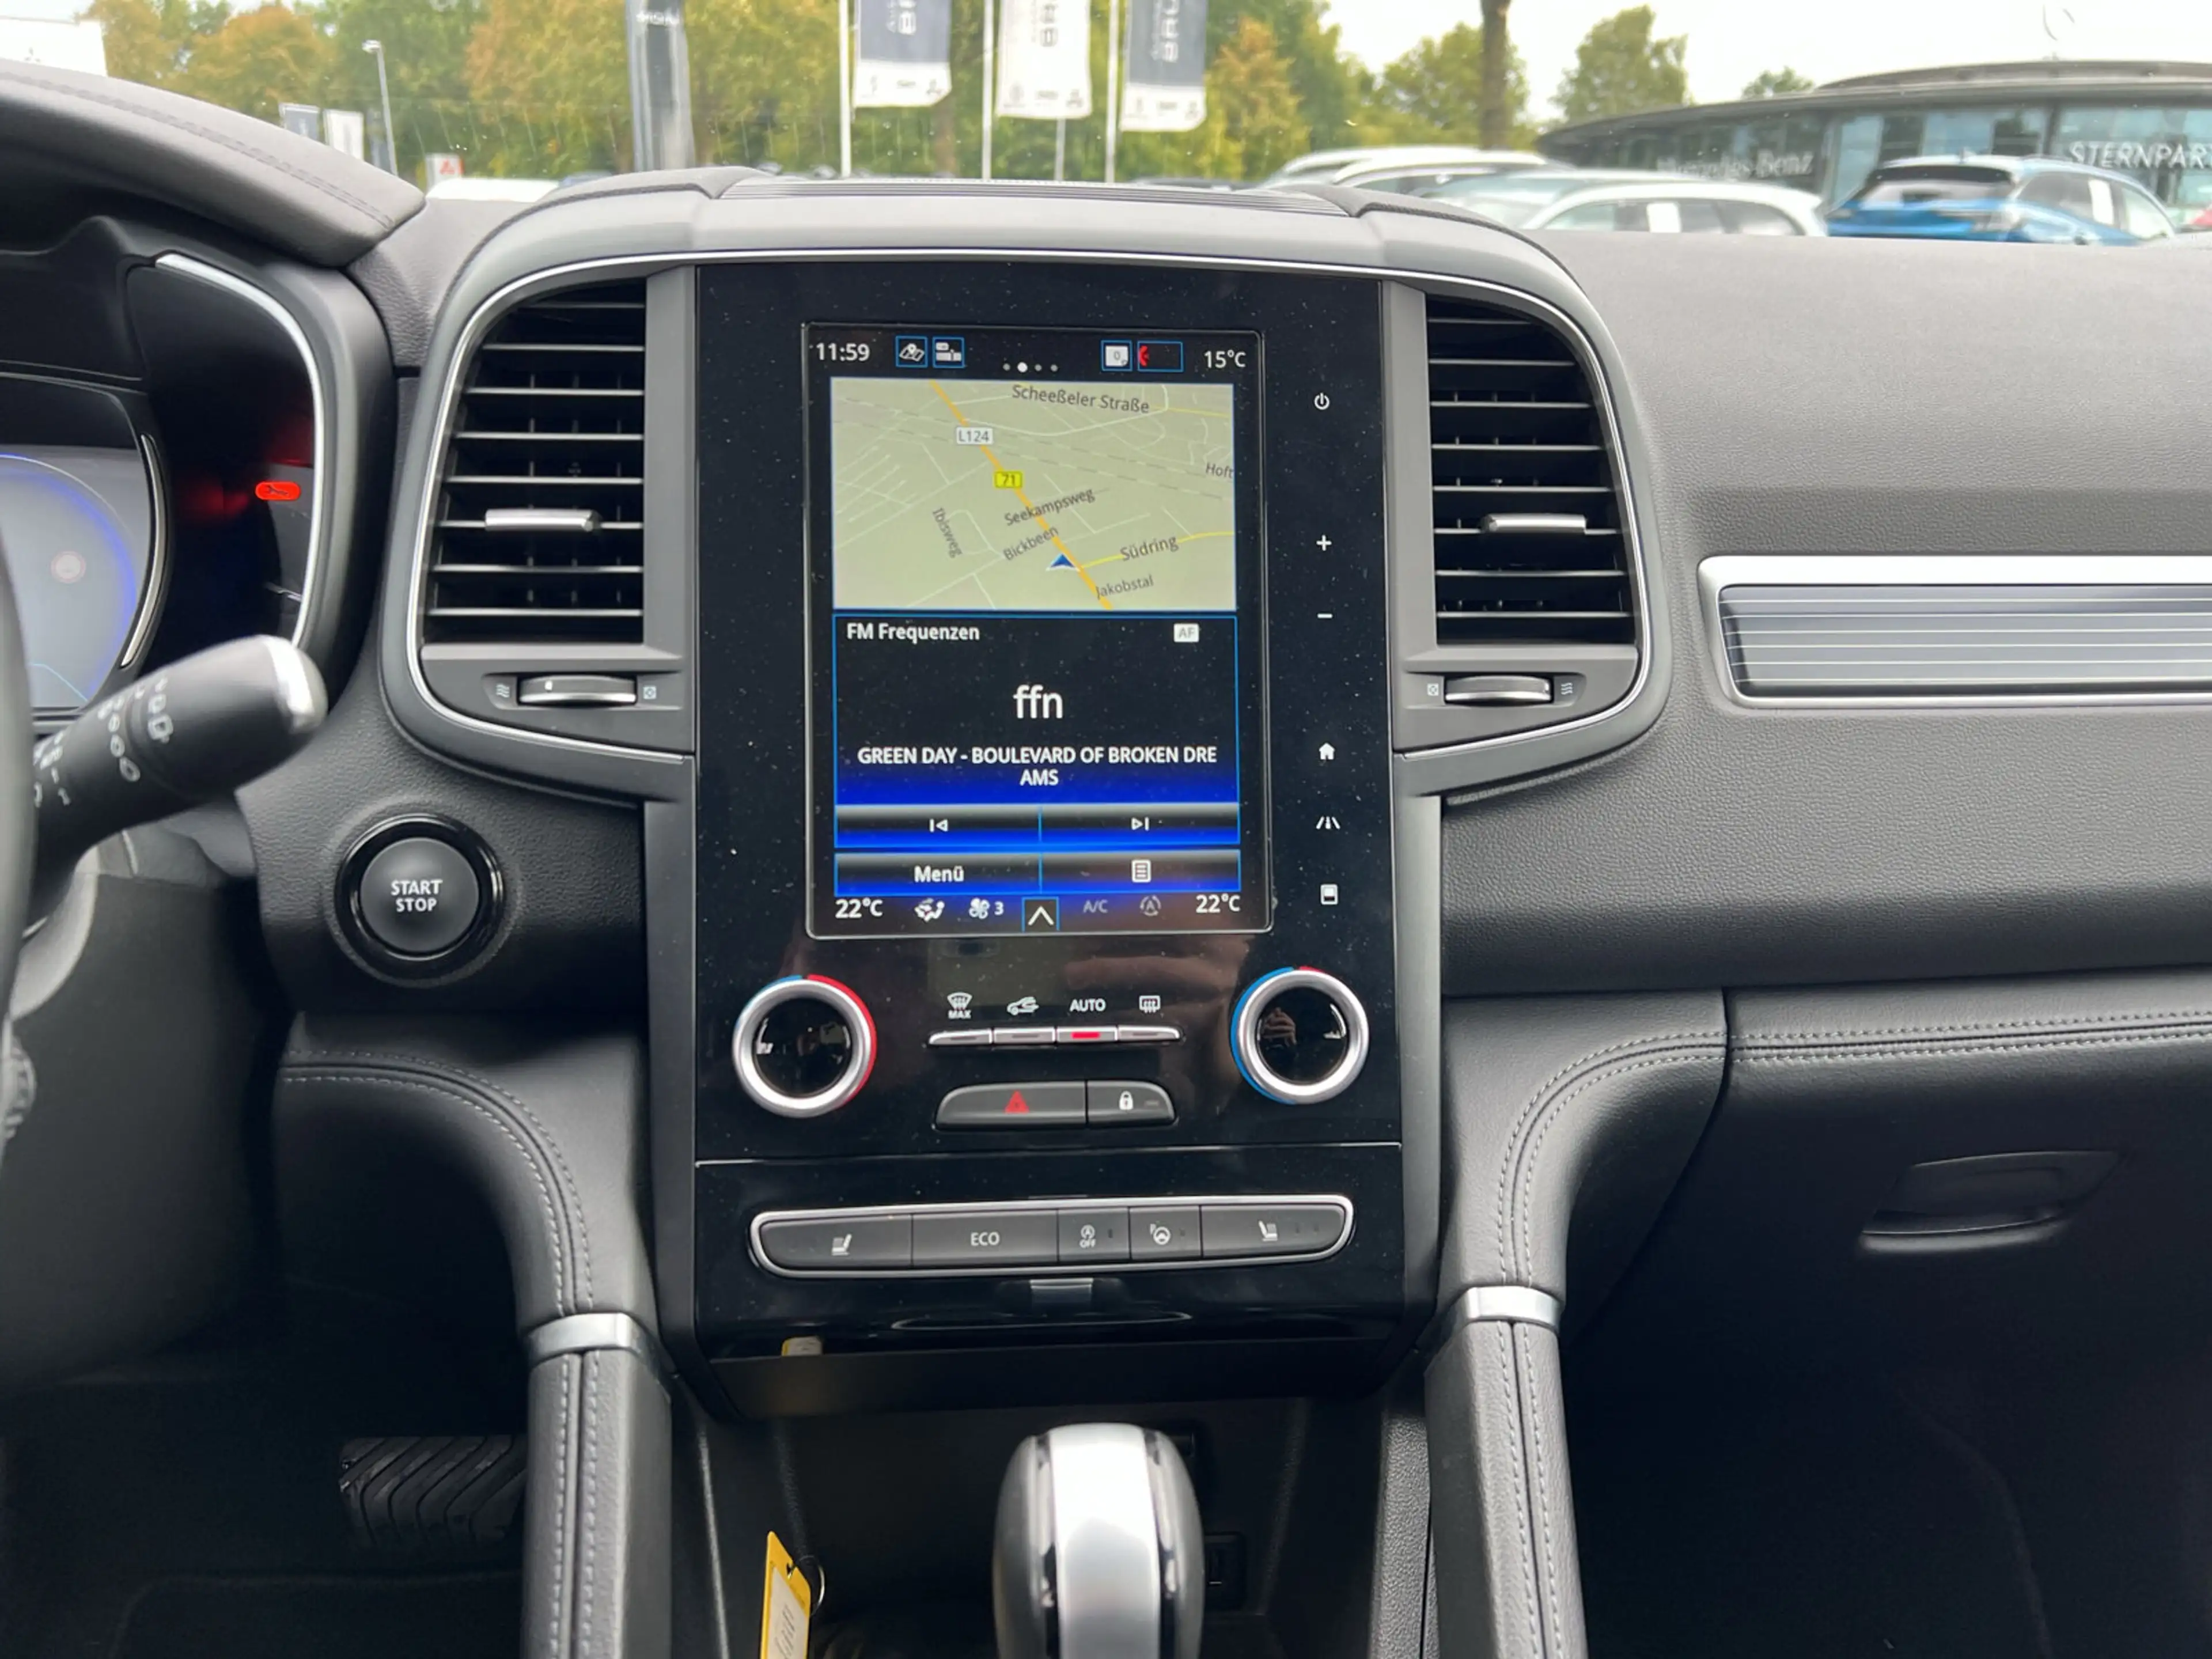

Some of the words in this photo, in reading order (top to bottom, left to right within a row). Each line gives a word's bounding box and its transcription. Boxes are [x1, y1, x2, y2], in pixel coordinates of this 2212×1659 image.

[816, 343, 870, 363] 11:59
[1204, 349, 1246, 369] 15°C
[1012, 384, 1097, 409] Scheeßeler
[1100, 394, 1150, 414] Straße
[958, 428, 990, 444] L124
[1002, 473, 1017, 486] 71
[1004, 487, 1096, 527] Seekampsweg
[1002, 525, 1059, 562] Bickbeen
[1120, 535, 1179, 562] Südring
[1096, 574, 1154, 599] Jakobstal
[847, 624, 874, 641] FM
[878, 624, 980, 644] Frequenzen
[1179, 627, 1195, 639] AF
[1012, 684, 1063, 720] ffn
[857, 747, 918, 765] GREEN
[922, 747, 958, 764] DAY
[972, 747, 1076, 764] BOULEVARD
[1080, 747, 1105, 764] OF
[1108, 747, 1179, 764] BROKEN
[1184, 747, 1217, 763] DRE
[1020, 769, 1059, 786] AMS
[914, 864, 965, 883] Menü
[391, 879, 443, 895] START
[396, 897, 437, 912] STOP
[835, 898, 884, 919] 22°C
[994, 902, 1005, 916] 3
[1083, 899, 1109, 914] A/C
[1196, 895, 1241, 914] 22°C
[1069, 998, 1106, 1013] AUTO
[948, 1010, 972, 1020] MAX
[970, 1232, 1001, 1247] ECO
[1079, 1238, 1096, 1249] OFF
